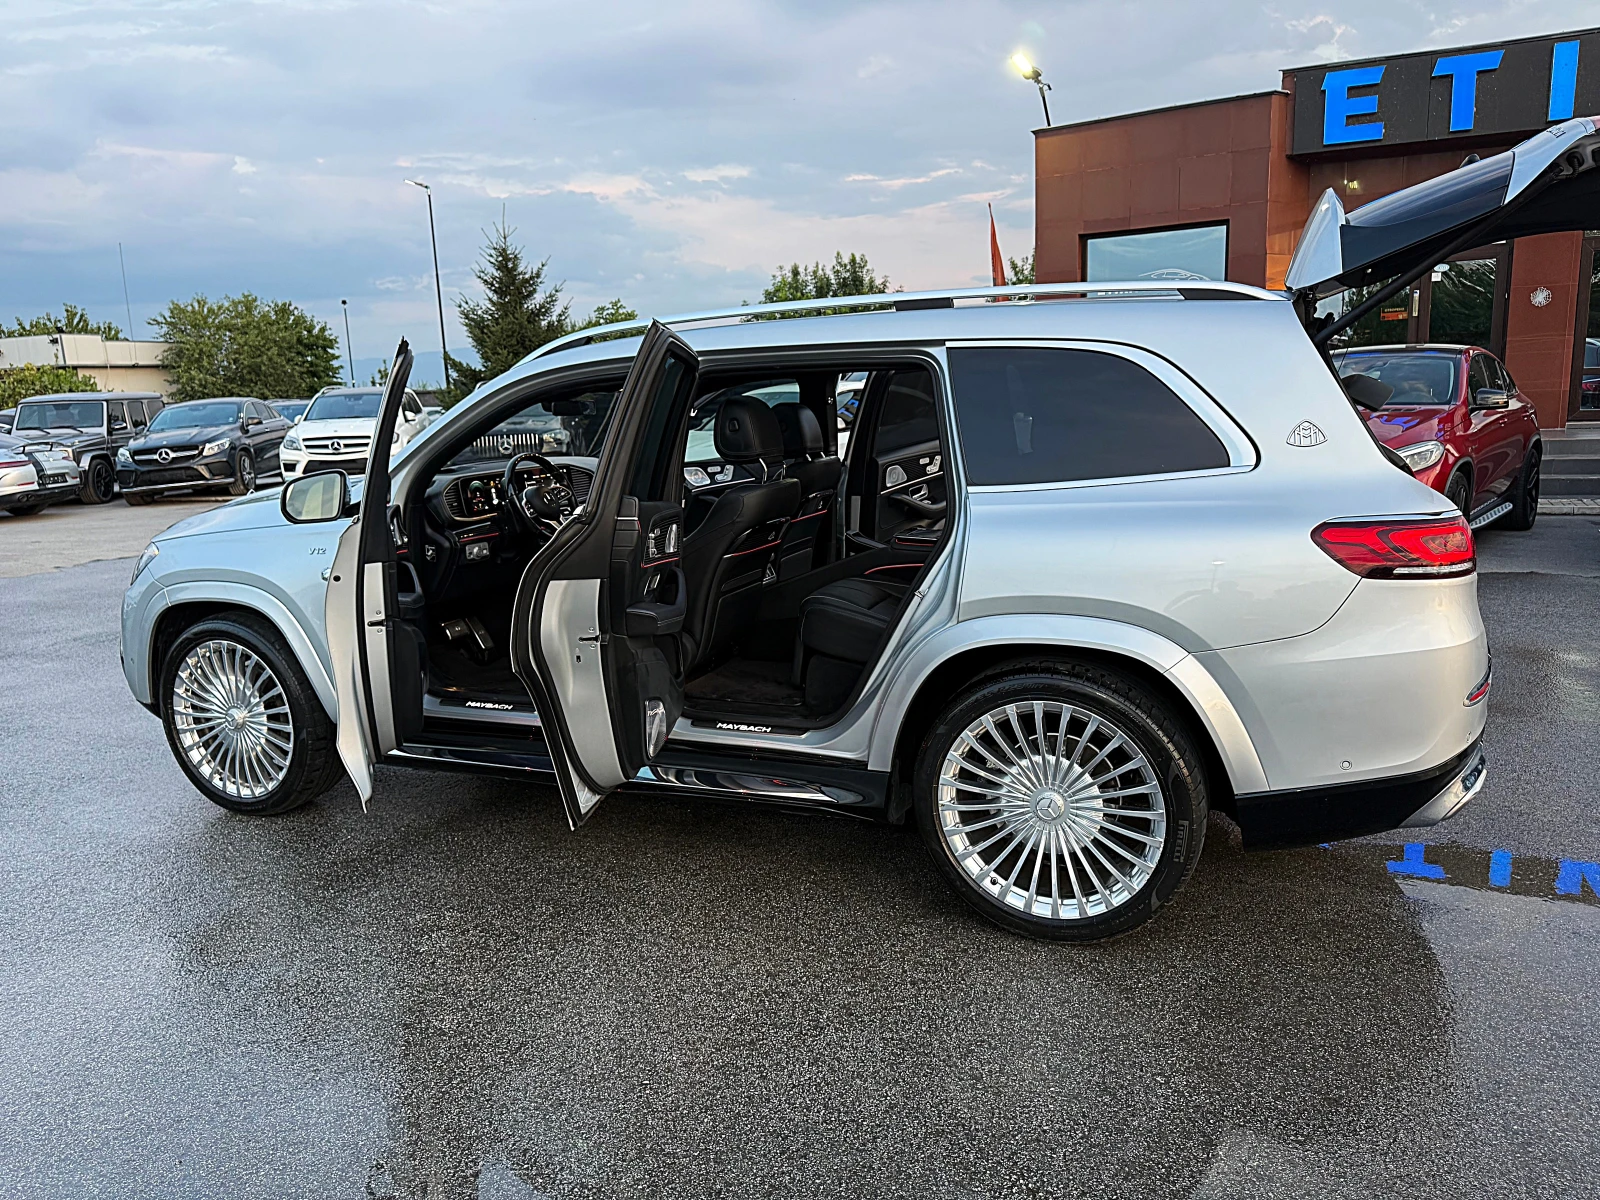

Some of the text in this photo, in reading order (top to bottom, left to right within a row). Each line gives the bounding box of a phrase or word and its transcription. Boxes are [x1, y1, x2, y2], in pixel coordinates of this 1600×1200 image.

[309, 547, 327, 556] V12
[465, 701, 514, 710] MAYBACH
[716, 722, 772, 733] MAYBACH
[1173, 820, 1189, 863] PIRELLI
